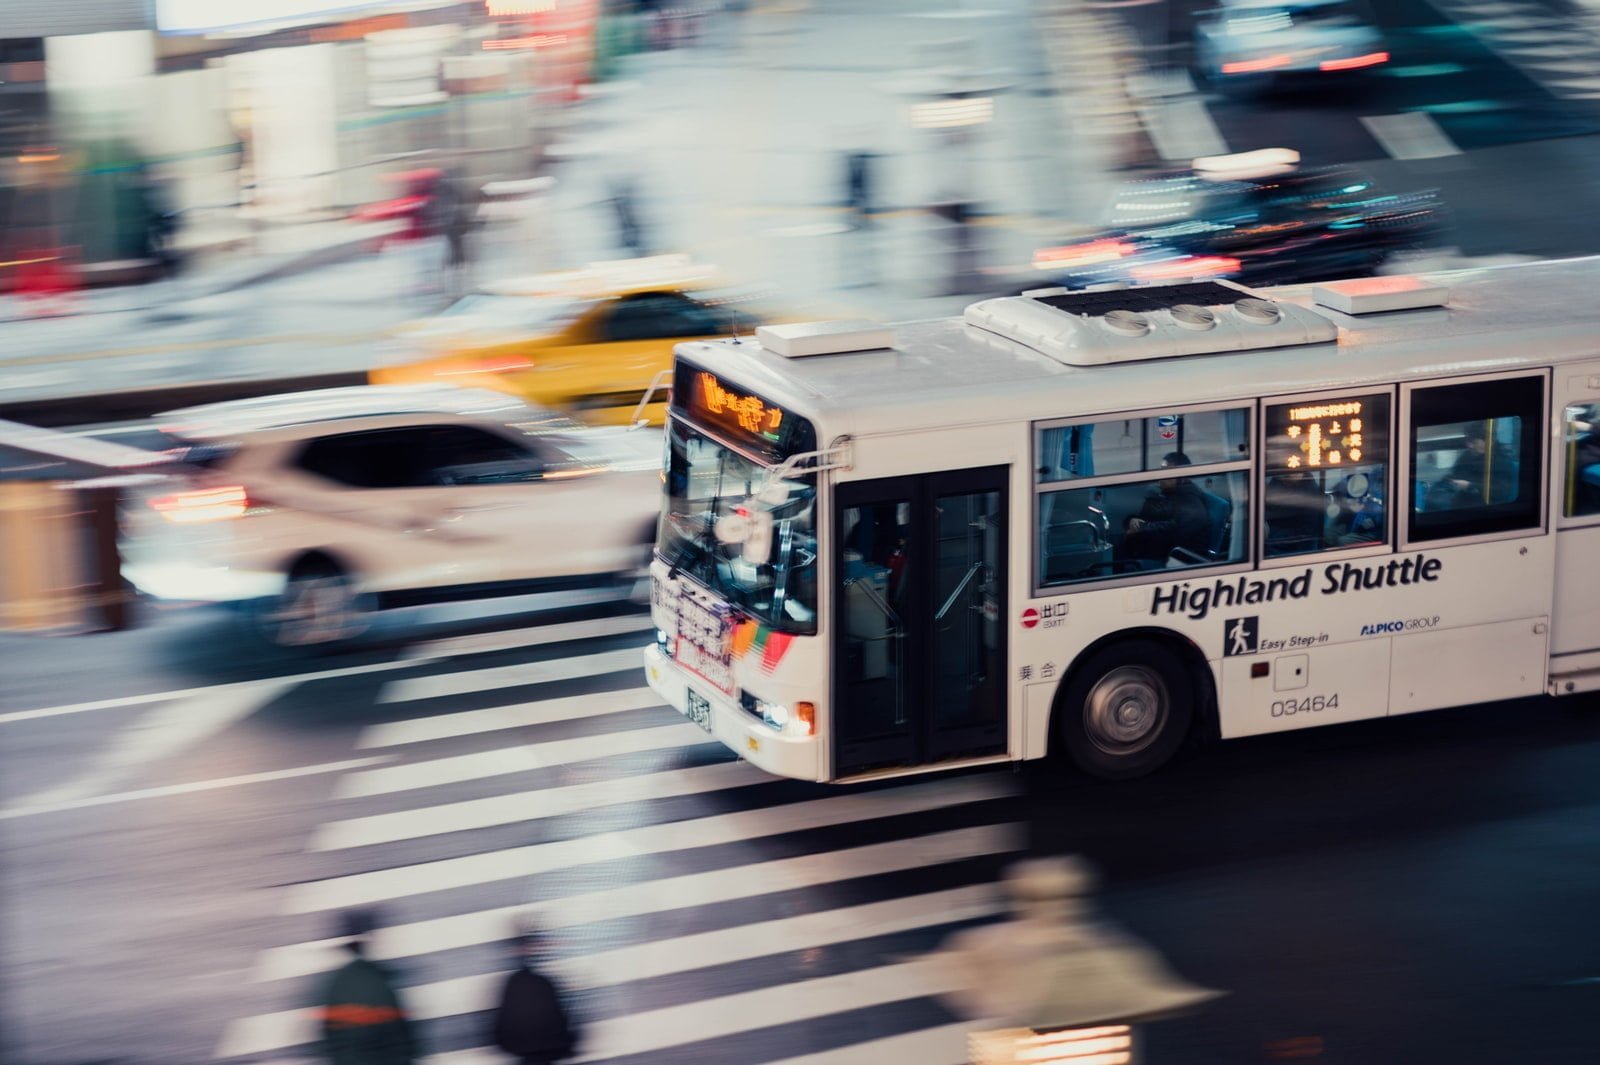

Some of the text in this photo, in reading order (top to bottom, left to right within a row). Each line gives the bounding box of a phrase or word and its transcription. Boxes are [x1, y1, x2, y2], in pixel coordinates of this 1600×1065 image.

[1150, 554, 1442, 620] Highland Shuttle
[1041, 602, 1069, 618] 出口
[1360, 616, 1440, 636] ALPICO GROUP
[1260, 632, 1329, 651] Easy Step-in
[1271, 693, 1339, 718] 03464
